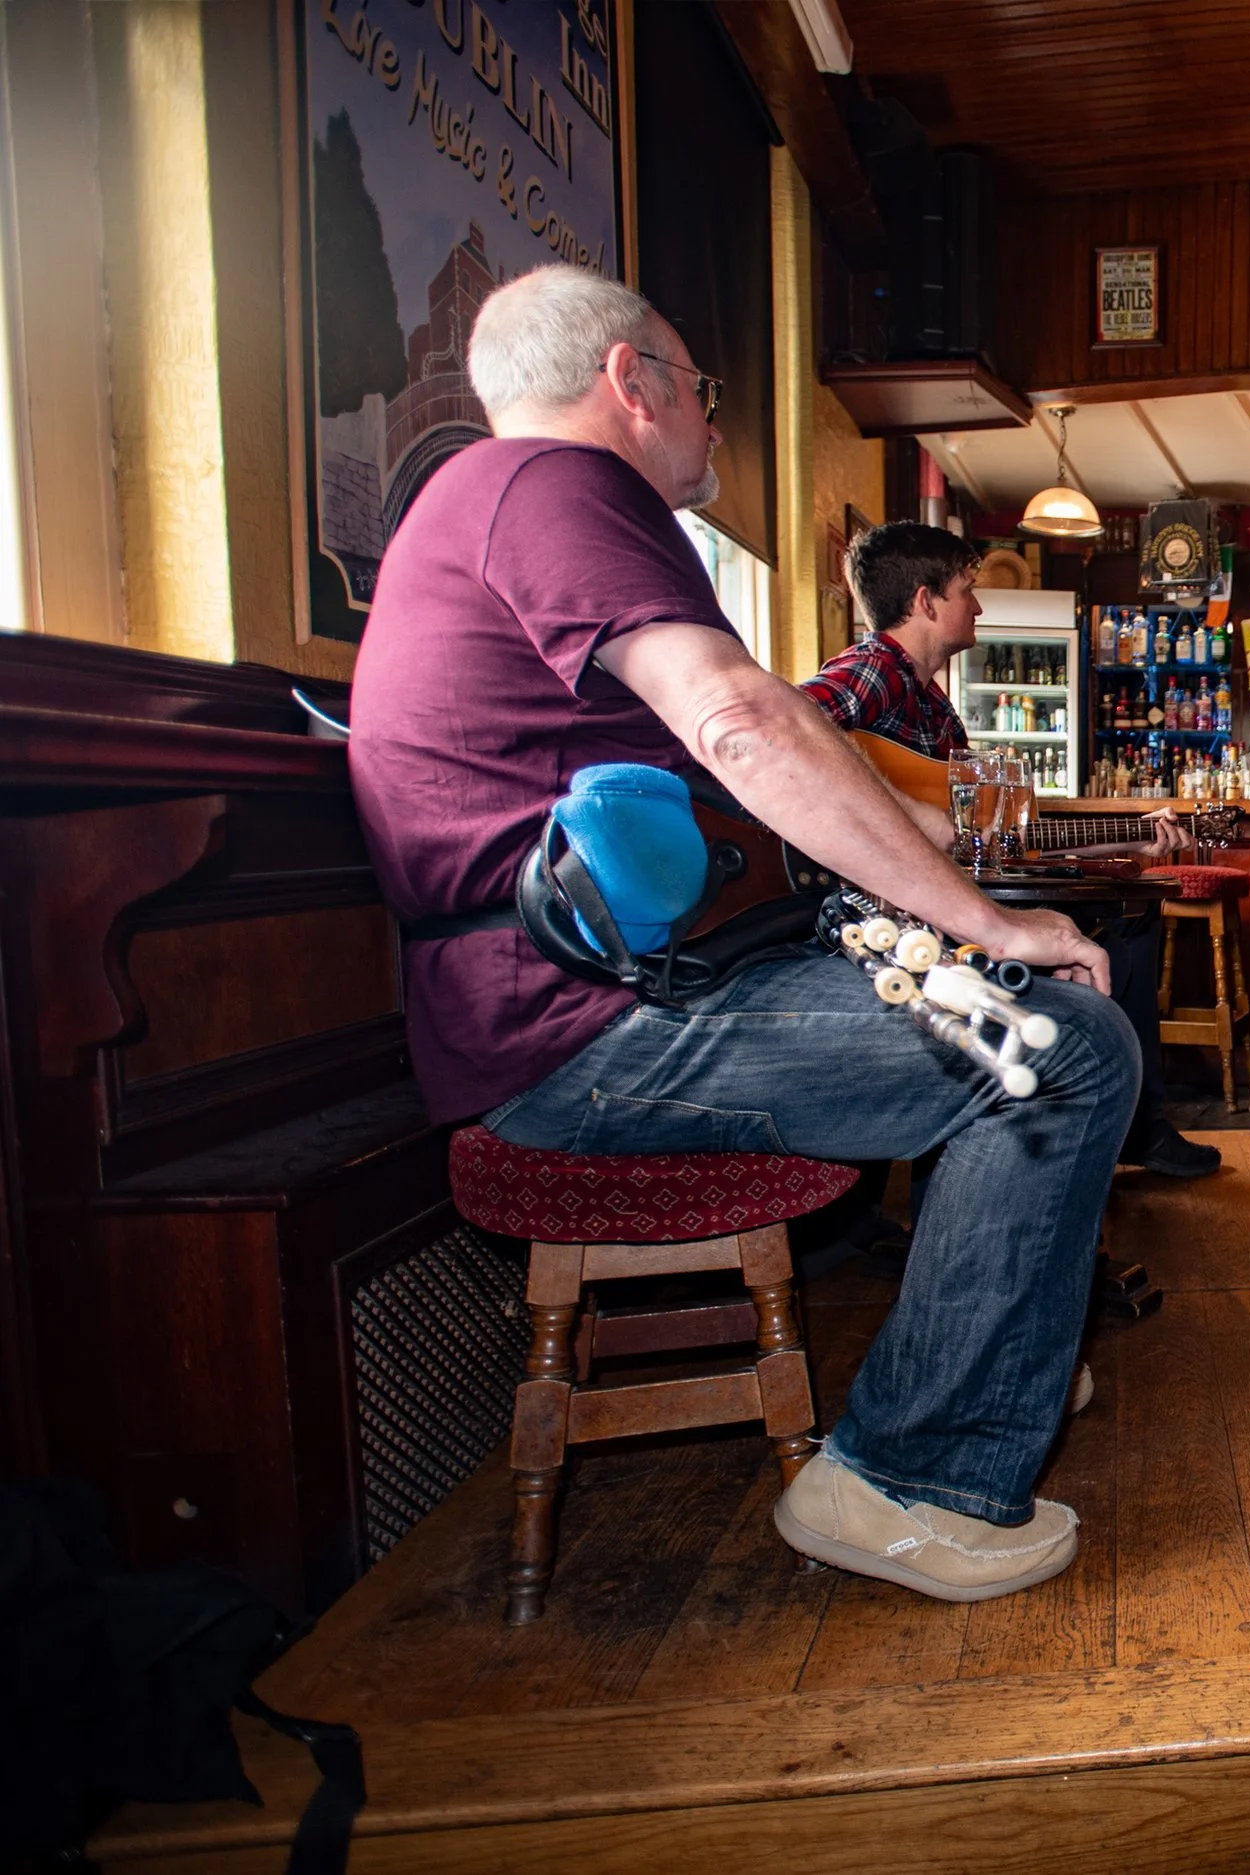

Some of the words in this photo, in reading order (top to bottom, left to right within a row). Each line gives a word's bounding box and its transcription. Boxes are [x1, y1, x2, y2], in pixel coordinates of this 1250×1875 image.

[408, 0, 573, 183] UBLIN
[558, 8, 609, 134] Inn
[409, 48, 486, 182] Music
[500, 143, 518, 219] &
[524, 175, 612, 281] Comed
[1103, 289, 1153, 311] BEATLES
